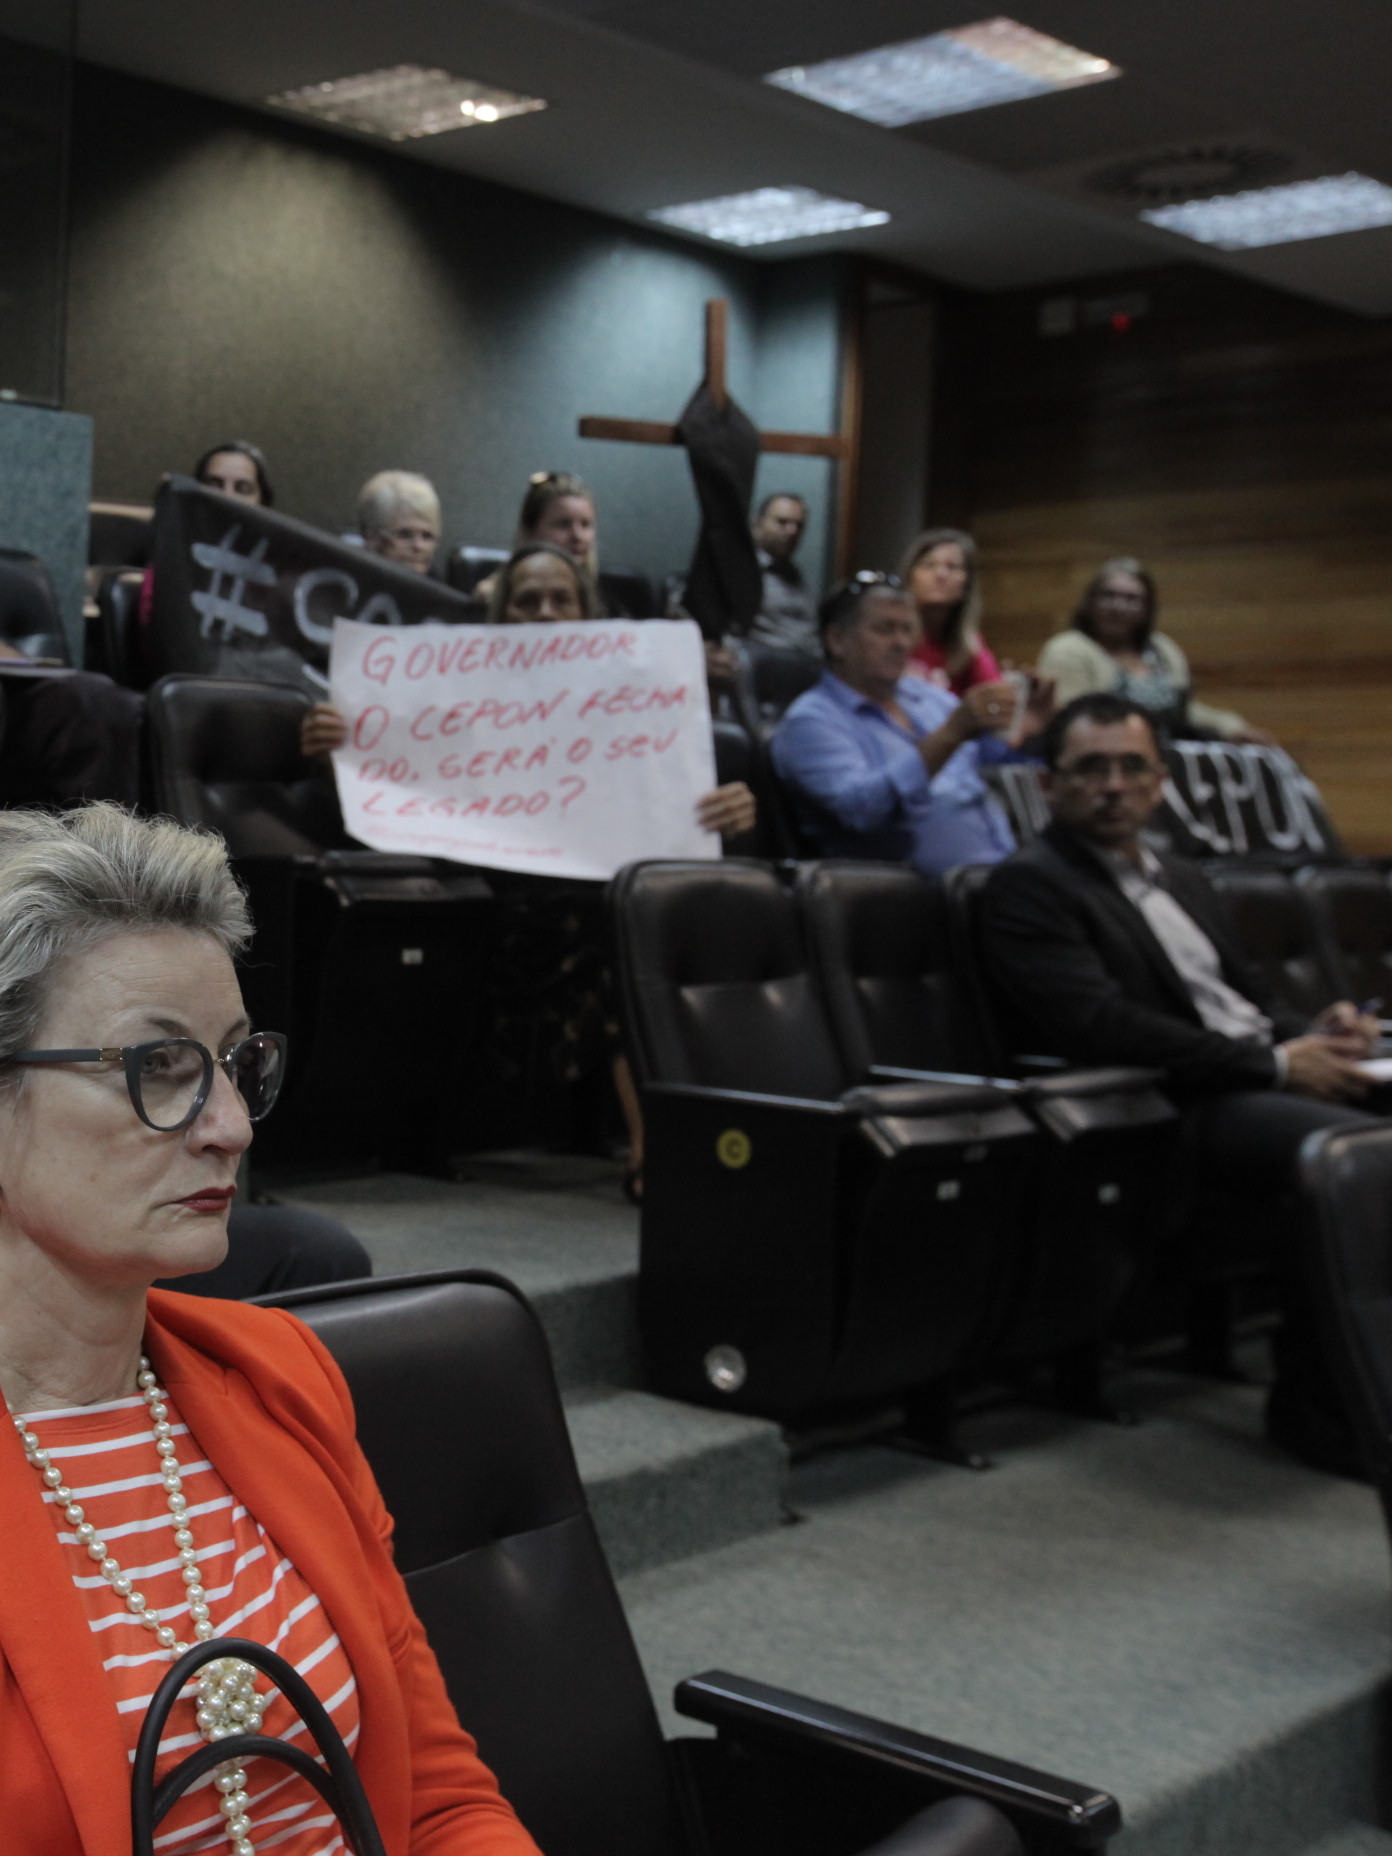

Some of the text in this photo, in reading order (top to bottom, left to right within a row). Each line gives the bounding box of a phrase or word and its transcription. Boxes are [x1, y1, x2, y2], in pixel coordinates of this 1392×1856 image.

[362, 631, 639, 686] GOVERNADOR
[352, 685, 688, 751] O CEPON FECHA
[566, 737, 593, 764] O
